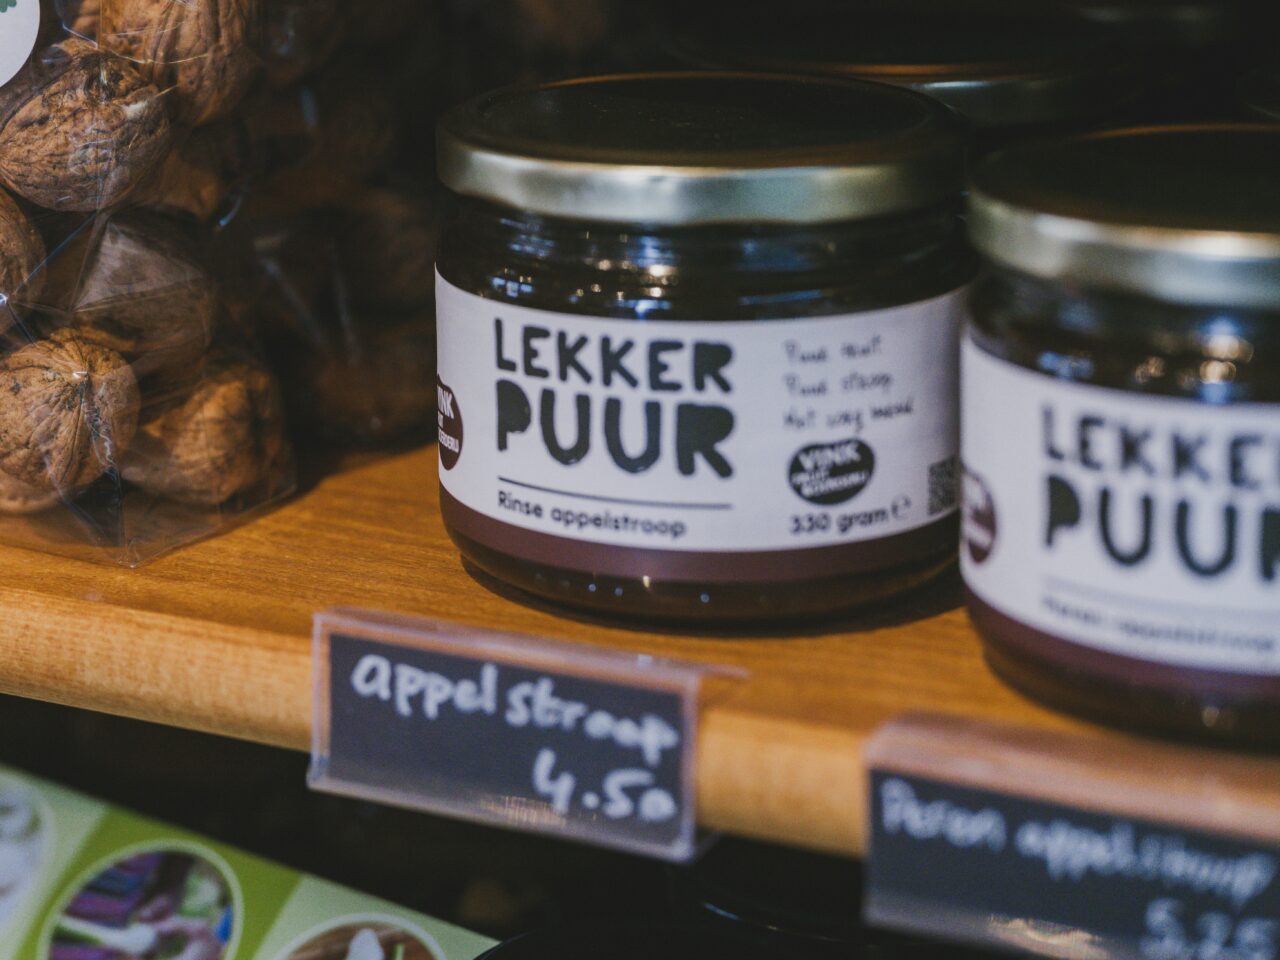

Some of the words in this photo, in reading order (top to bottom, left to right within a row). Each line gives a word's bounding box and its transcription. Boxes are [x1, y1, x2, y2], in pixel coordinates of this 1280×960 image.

[494, 317, 733, 393] LEKKER
[495, 378, 734, 479] PUUR
[498, 490, 544, 518] Rinse
[550, 506, 687, 538] appelstroop
[836, 507, 889, 534] gram
